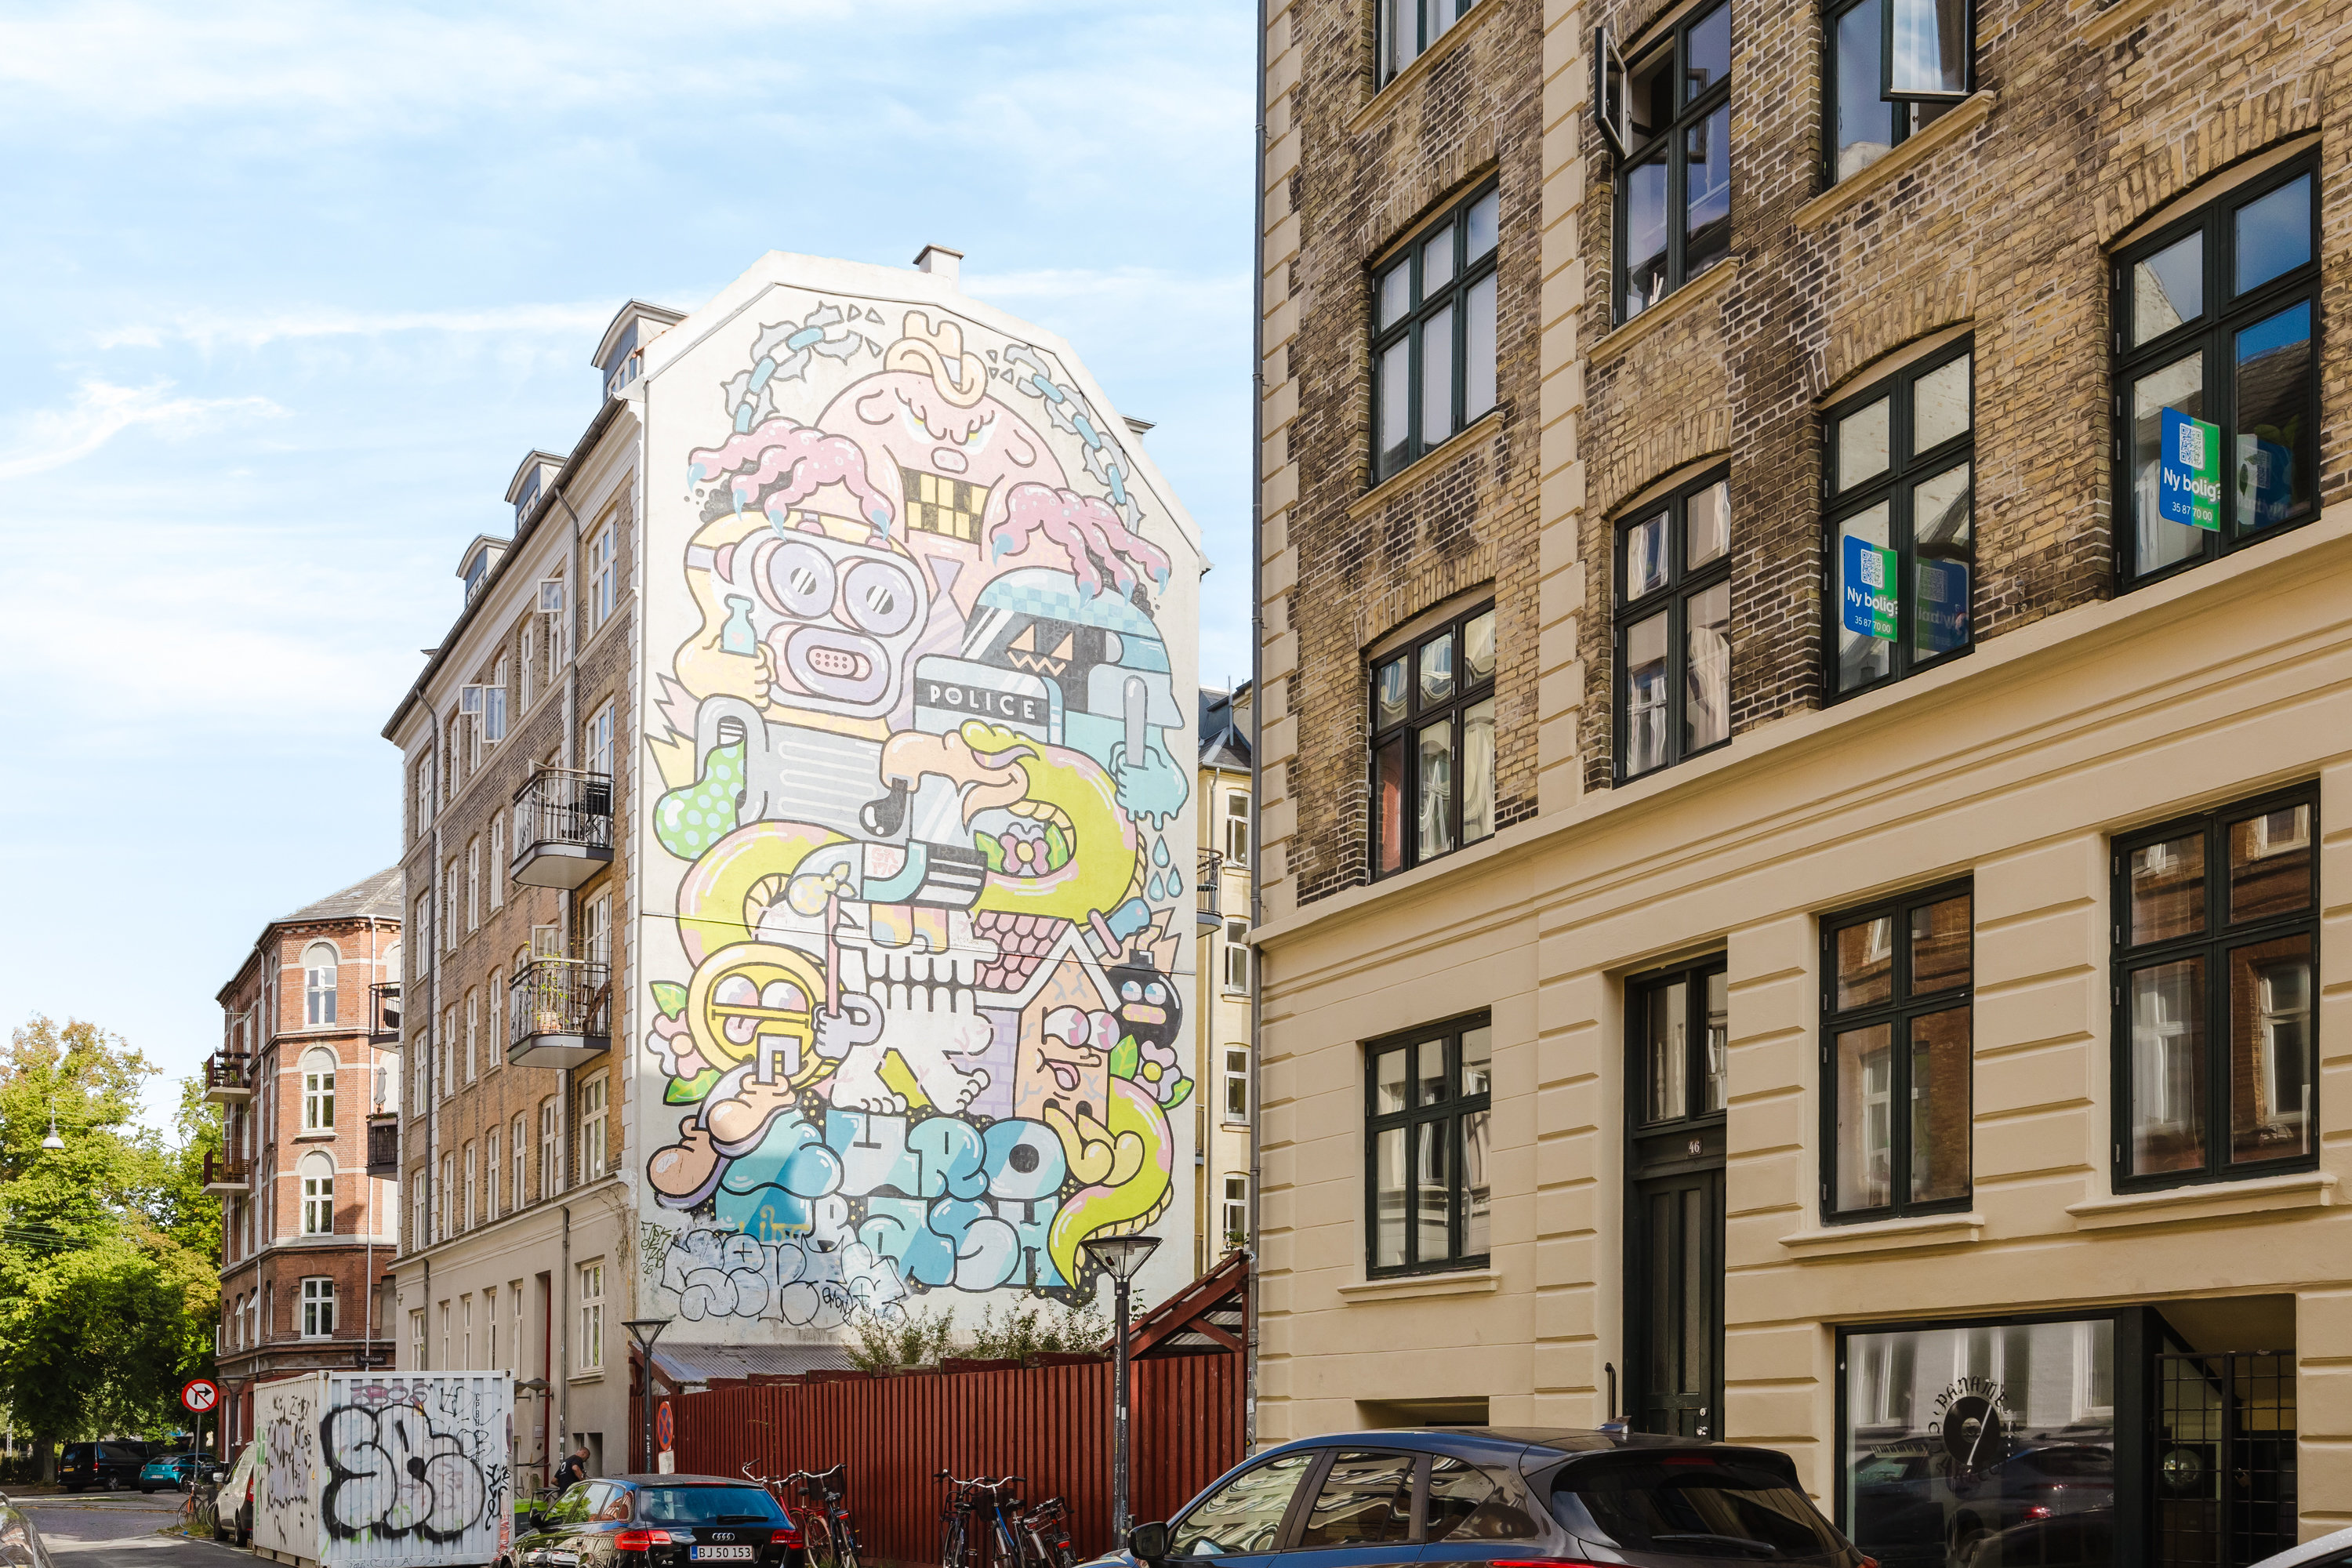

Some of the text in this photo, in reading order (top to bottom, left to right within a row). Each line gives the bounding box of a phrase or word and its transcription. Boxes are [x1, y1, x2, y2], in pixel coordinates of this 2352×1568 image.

[2164, 467, 2221, 502] Ny bolig?
[2172, 502, 2212, 521] 35 87 70 00
[1847, 586, 1862, 608] Ny
[1855, 615, 1891, 633] 35 87 70 00
[930, 684, 1036, 720] POLICE
[1689, 1141, 1700, 1153] 46
[699, 1547, 751, 1558] BJ 50 153
